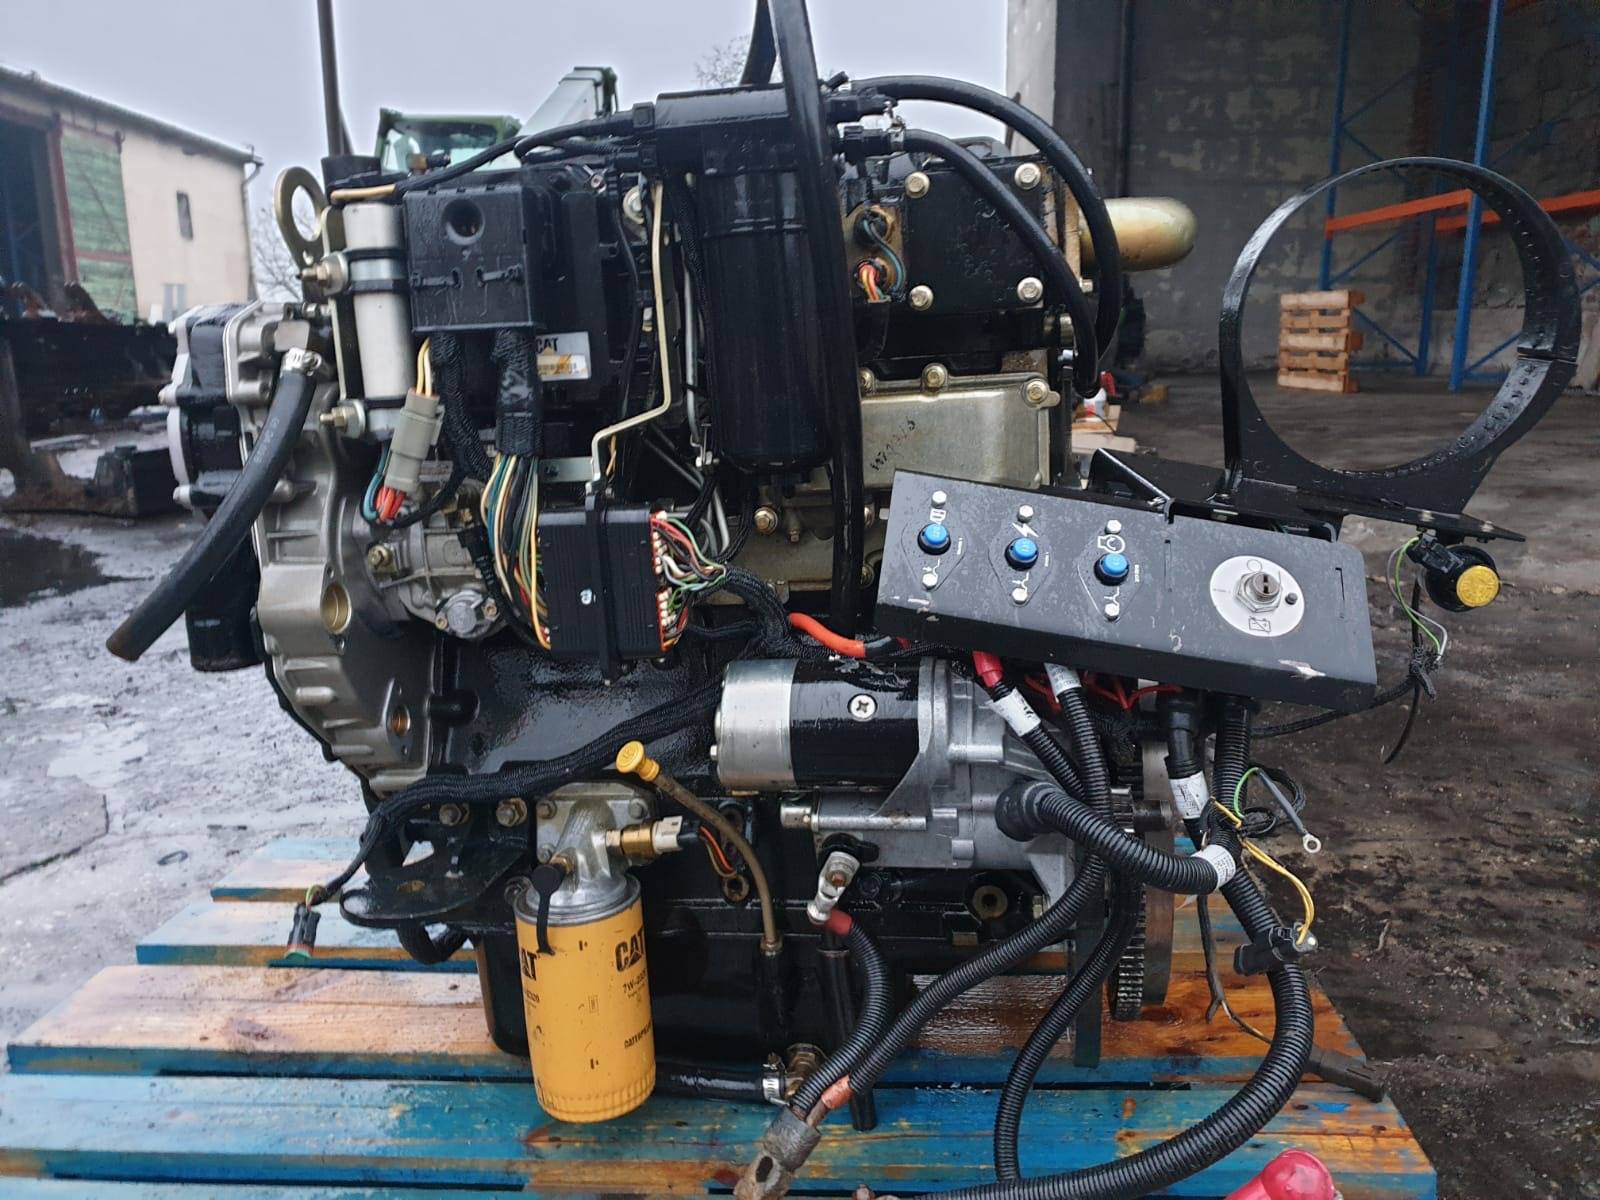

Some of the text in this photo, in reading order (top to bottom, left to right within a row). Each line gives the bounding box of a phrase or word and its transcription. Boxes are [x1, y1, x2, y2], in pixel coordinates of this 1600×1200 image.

[535, 336, 559, 354] CAT
[521, 948, 537, 981] AT
[615, 926, 645, 973] CAT
